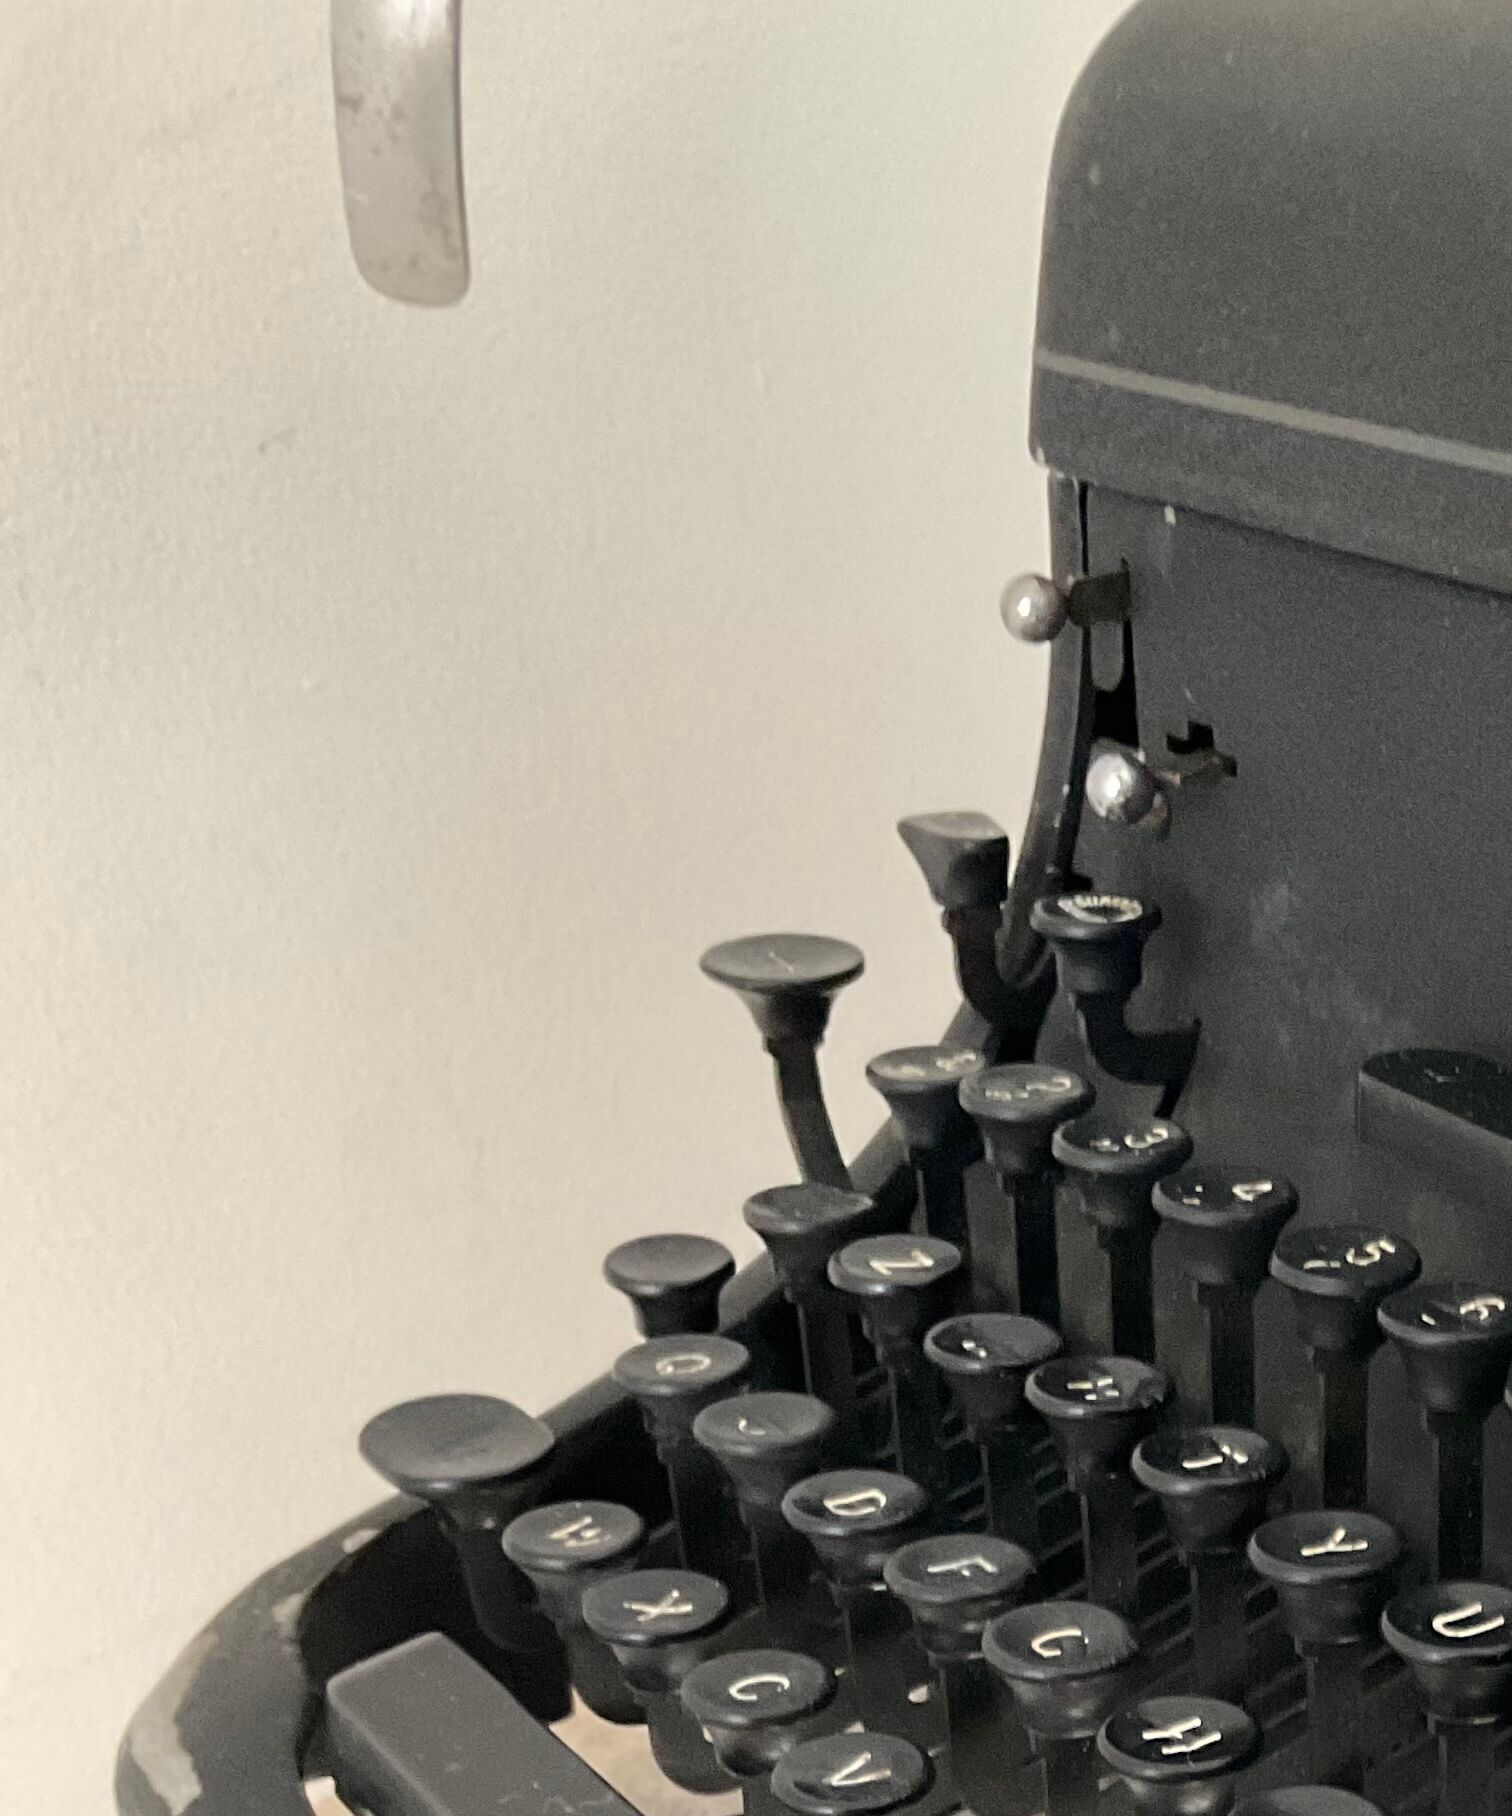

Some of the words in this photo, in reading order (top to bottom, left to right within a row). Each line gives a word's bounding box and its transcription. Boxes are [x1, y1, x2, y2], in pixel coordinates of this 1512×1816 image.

[1345, 1238, 1396, 1267] 5
[823, 1488, 887, 1517] D
[1300, 1527, 1369, 1557] Y
[926, 1554, 998, 1577] F
[623, 1589, 694, 1622] X
[1432, 1601, 1505, 1638] U
[1142, 1715, 1222, 1755] H
[822, 1751, 892, 1787] V
